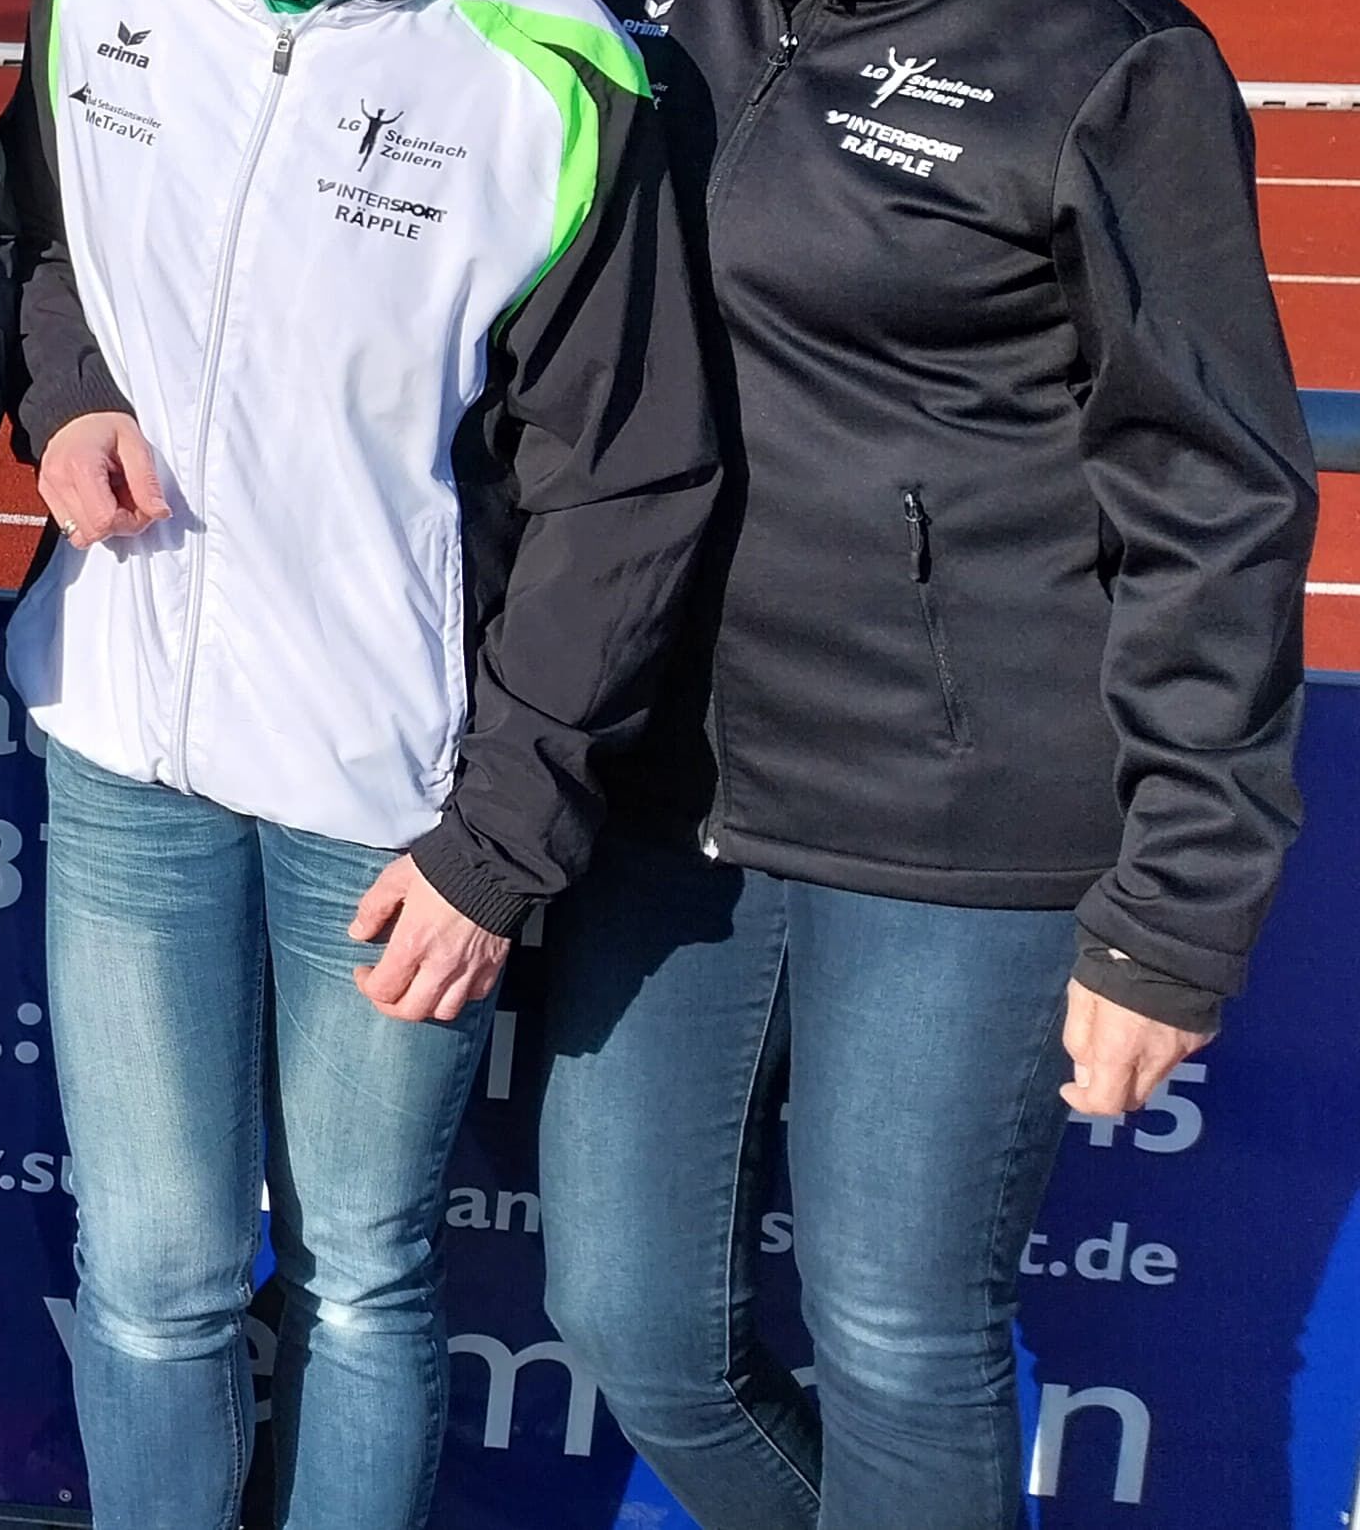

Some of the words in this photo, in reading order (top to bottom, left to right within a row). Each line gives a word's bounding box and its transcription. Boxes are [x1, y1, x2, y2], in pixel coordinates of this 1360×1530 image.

[97, 43, 150, 69] erima
[860, 64, 889, 79] LG
[907, 74, 995, 102] Steinlach
[898, 84, 965, 108] Zollern
[337, 117, 362, 132] LG
[384, 129, 468, 159] Steinlach
[379, 144, 443, 169] Zollern
[840, 134, 934, 178] RÄPPLE
[846, 115, 964, 162] INTERSPORT
[335, 204, 421, 240] RÄPPLE
[337, 183, 448, 223] INTERSPORT
